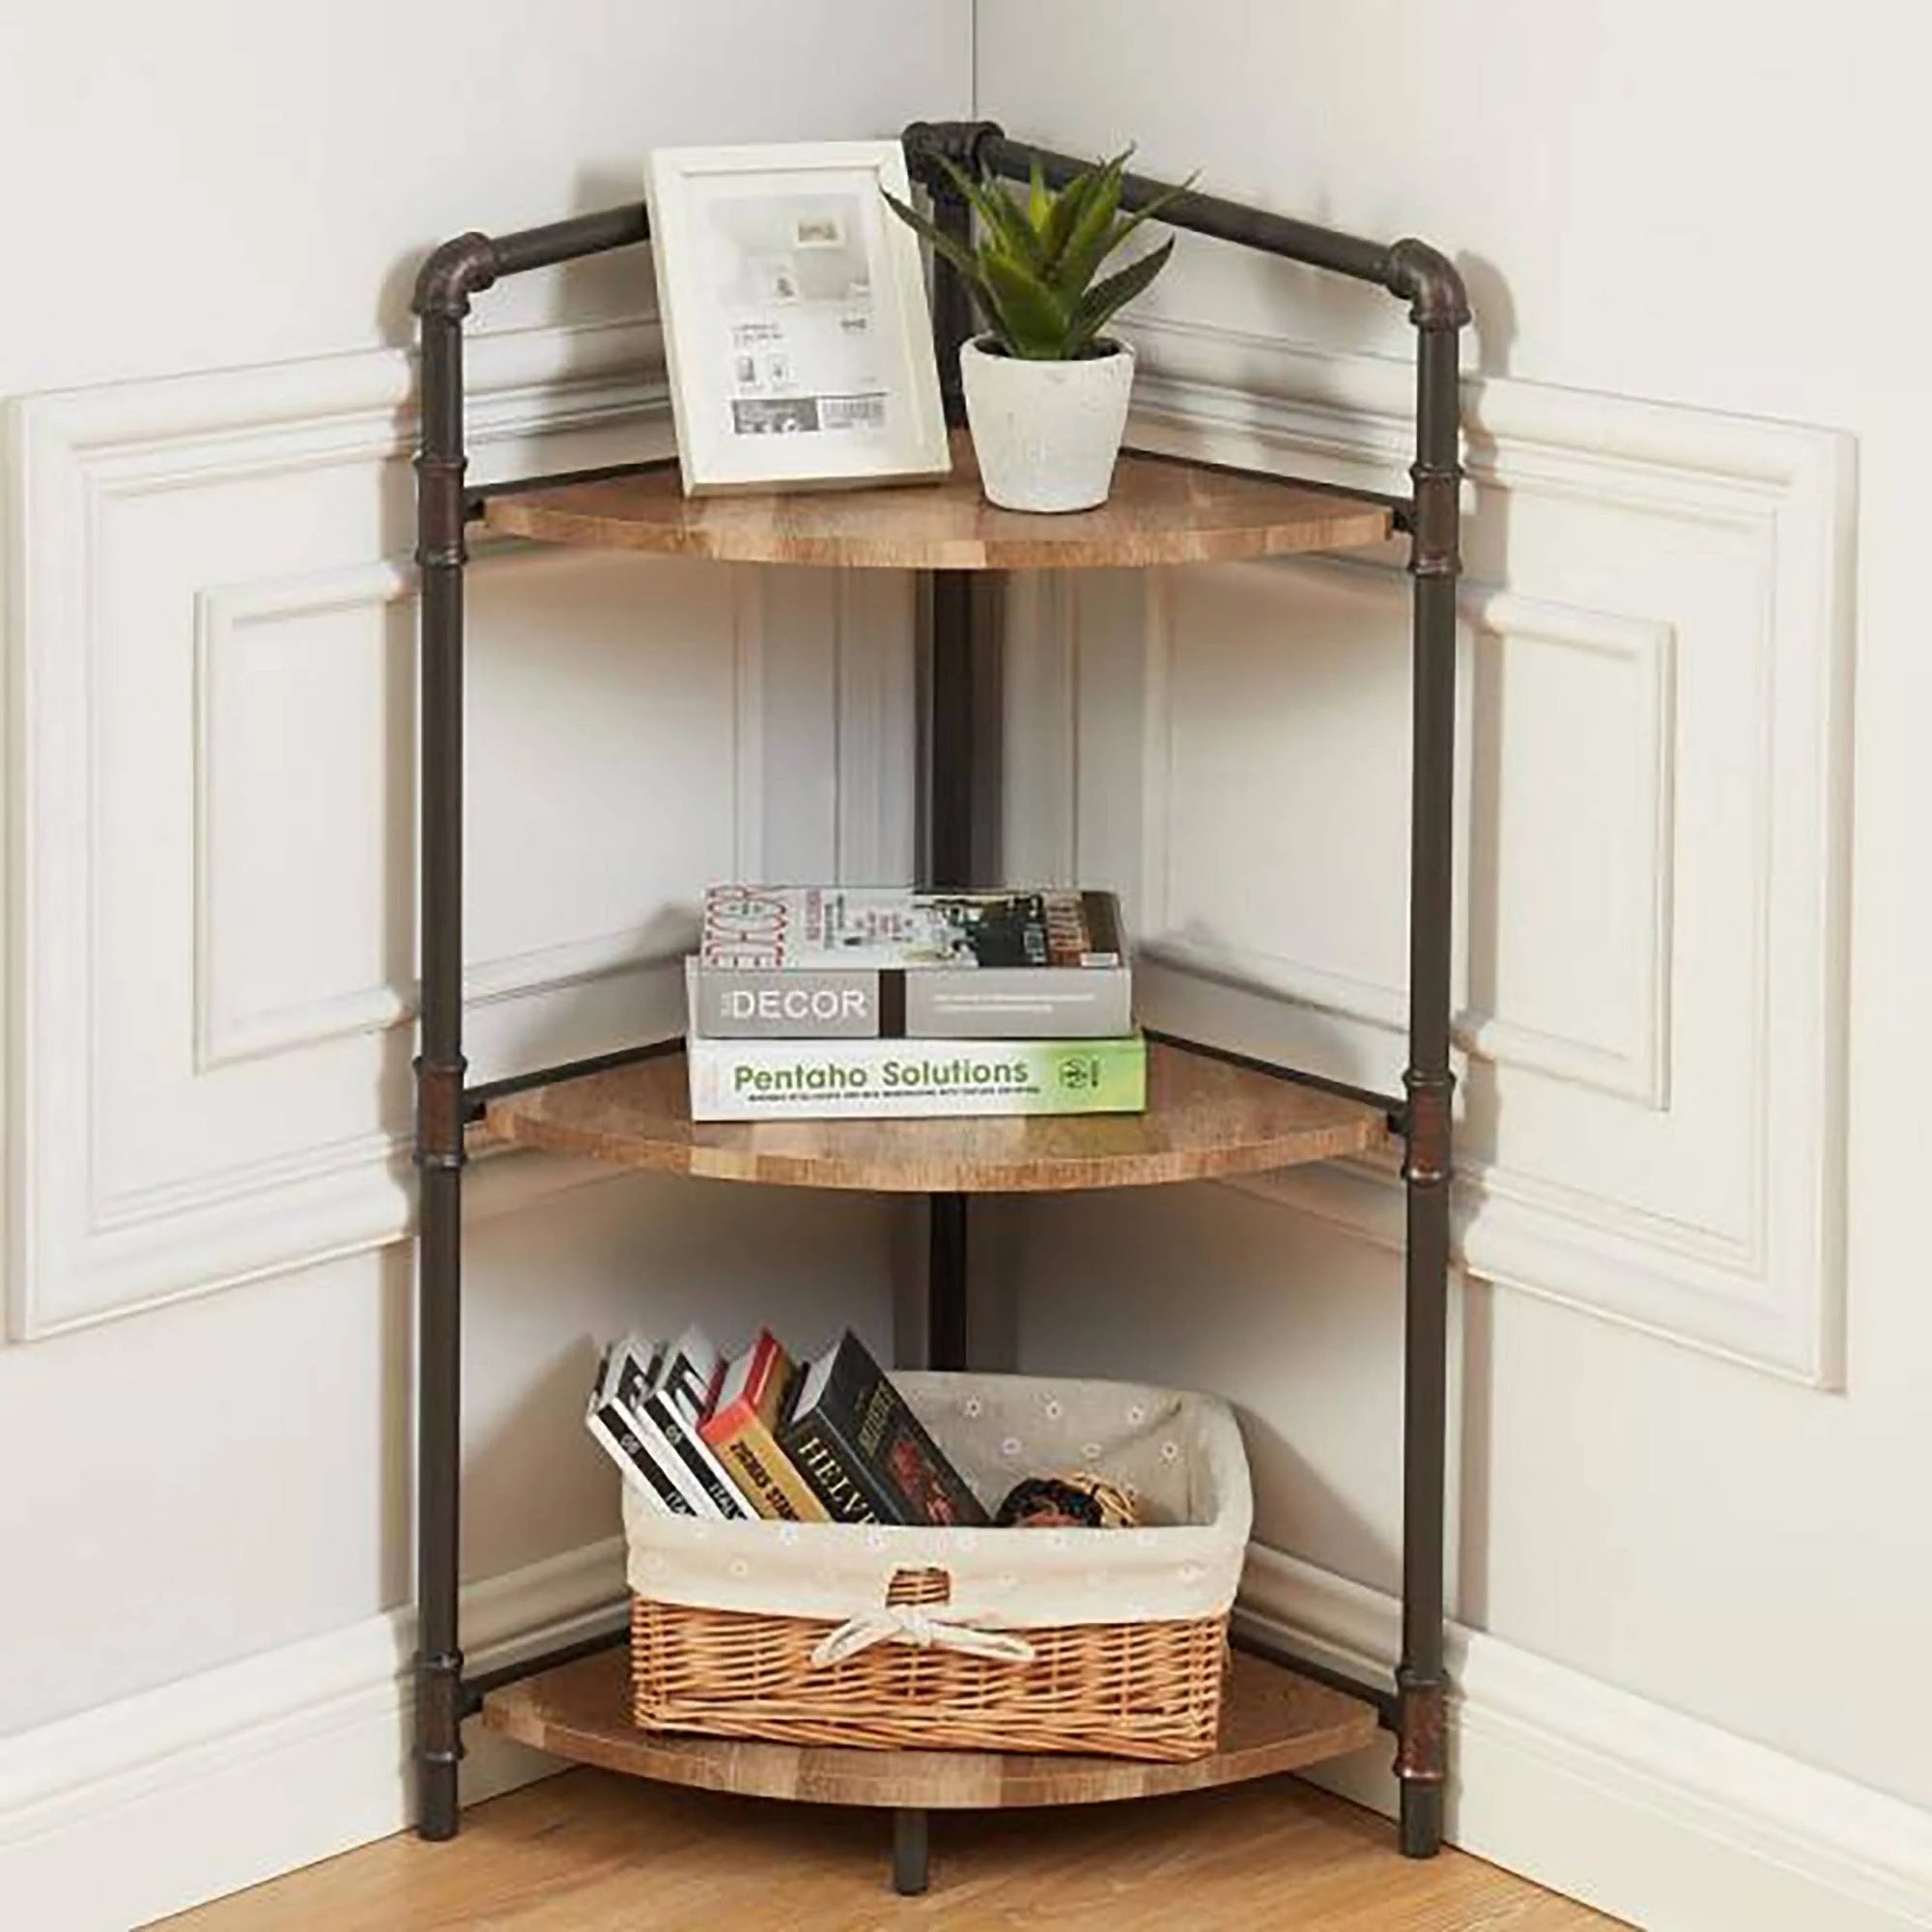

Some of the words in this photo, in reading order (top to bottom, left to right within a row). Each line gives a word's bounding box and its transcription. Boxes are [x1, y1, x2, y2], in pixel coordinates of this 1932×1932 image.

[732, 990, 867, 1018] DECOR
[734, 1063, 867, 1092] Pentaho
[882, 1060, 1029, 1086] Solutions
